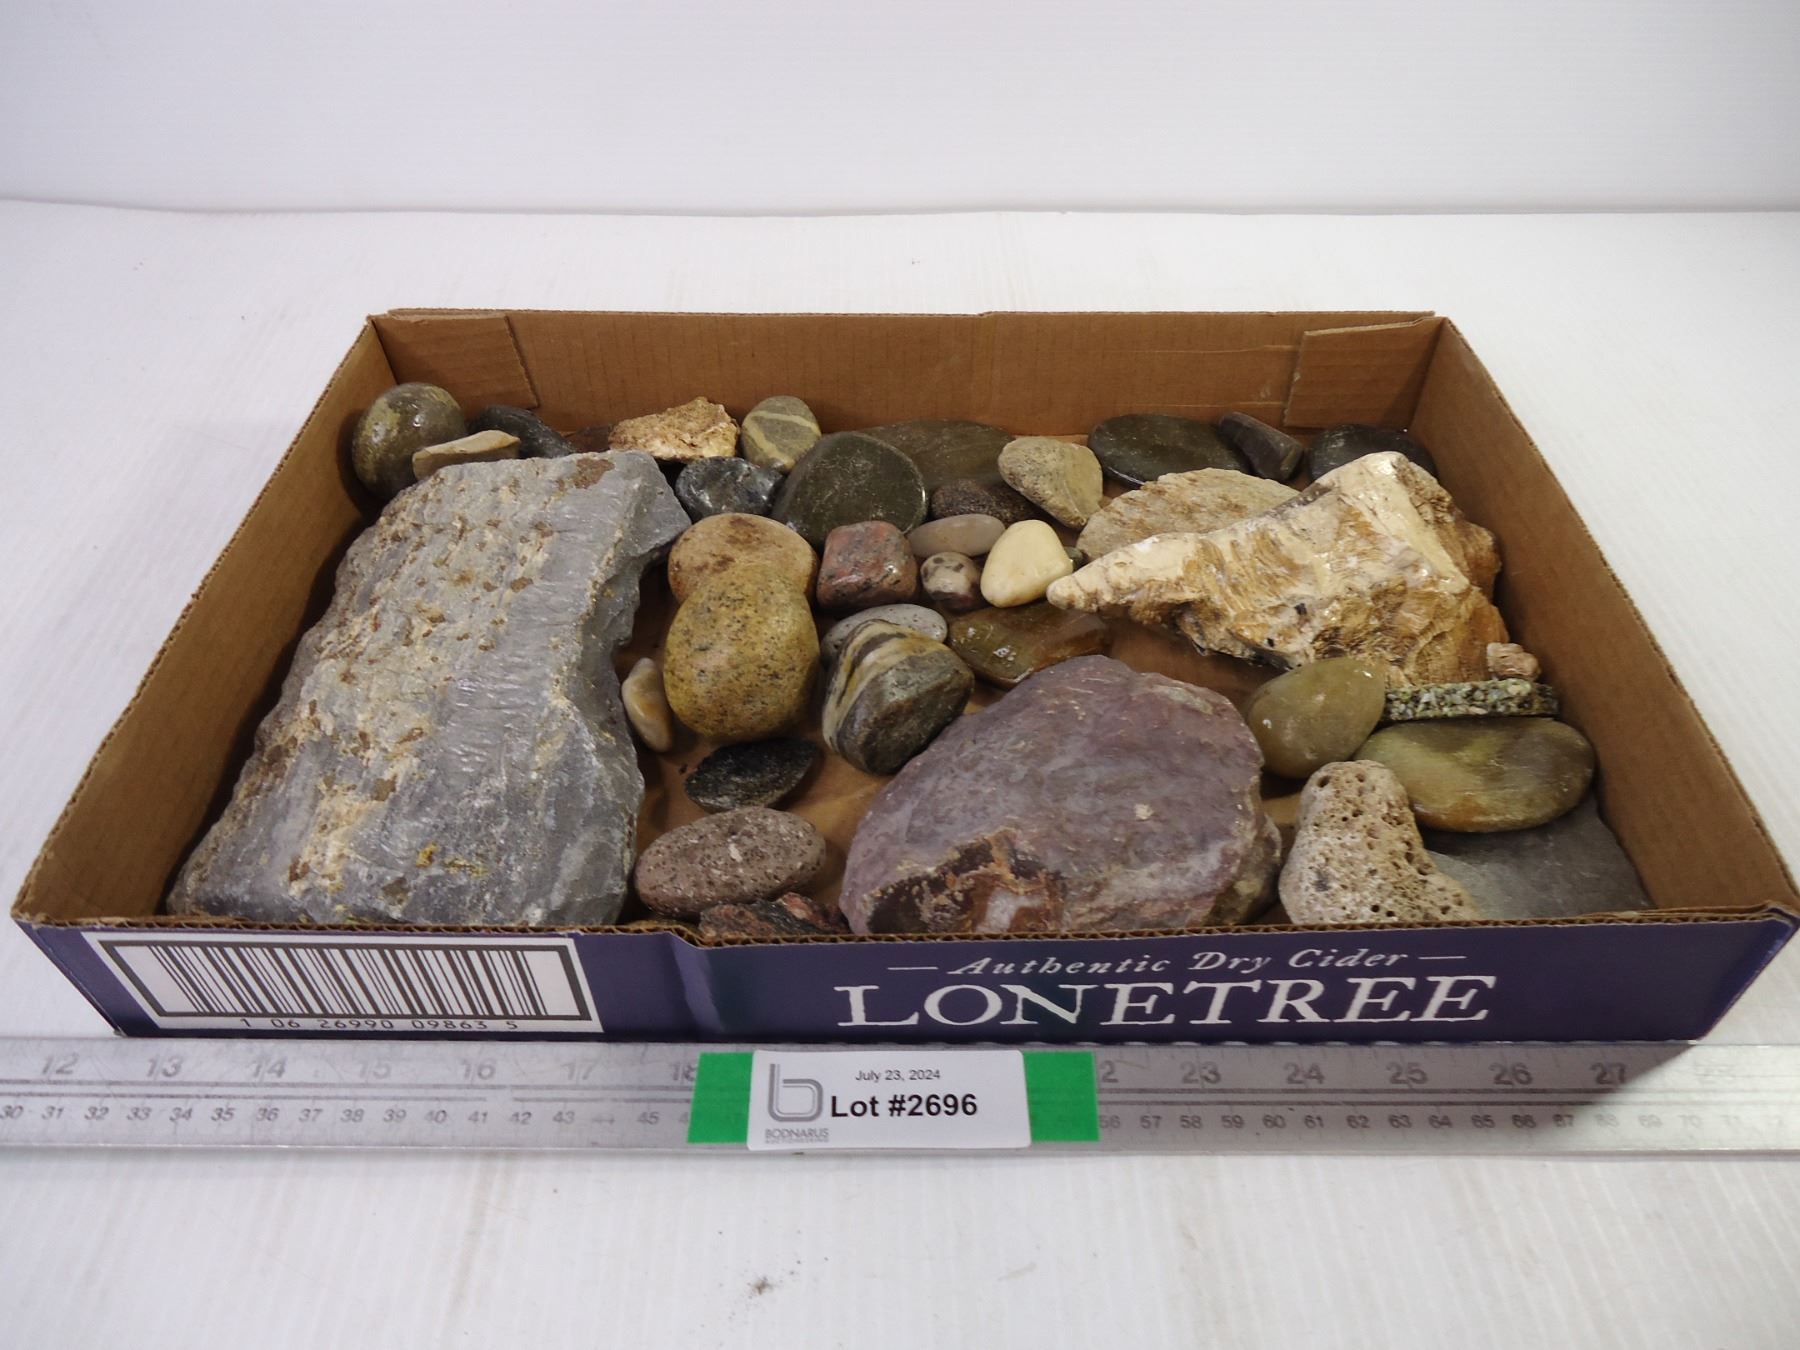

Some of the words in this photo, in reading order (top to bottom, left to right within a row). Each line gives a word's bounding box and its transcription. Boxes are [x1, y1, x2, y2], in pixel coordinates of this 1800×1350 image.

[947, 954, 1170, 975] Authentic
[1188, 951, 1272, 974] Dry
[1288, 948, 1408, 968] Cider
[833, 975, 1497, 1027] LONETREE
[240, 1018, 251, 1028] 1
[270, 1018, 301, 1029] 06
[319, 1019, 394, 1030] 26990
[411, 1020, 488, 1030] 09863
[509, 1021, 519, 1030] 5
[42, 1052, 78, 1075] 12
[147, 1054, 182, 1078] 13
[252, 1057, 287, 1078] 14
[358, 1059, 392, 1079] 15
[461, 1059, 496, 1080] 16
[562, 1061, 595, 1081] 17
[855, 1070, 880, 1083] July
[885, 1069, 905, 1082] 23,
[909, 1069, 941, 1080] 2024
[1100, 1060, 1119, 1083] 2
[1180, 1061, 1221, 1084] 23
[1283, 1062, 1325, 1085] 24
[1386, 1062, 1428, 1085] 25
[1489, 1062, 1533, 1085] 26
[1591, 1062, 1627, 1085] 27
[41, 1106, 64, 1120] 31
[84, 1106, 110, 1121] 32
[126, 1107, 152, 1121] 33
[169, 1107, 193, 1122] 34
[210, 1107, 236, 1122] 35
[256, 1107, 280, 1122] 36
[299, 1108, 323, 1122] 37
[340, 1109, 365, 1123] 38
[383, 1109, 407, 1123] 39
[424, 1109, 448, 1124] 40
[468, 1110, 488, 1124] 41
[509, 1111, 532, 1125] 42
[553, 1111, 575, 1125] 43
[637, 1111, 660, 1126] 45
[831, 1095, 880, 1118] Lot
[888, 1093, 978, 1117] #2696
[1140, 1115, 1162, 1129] 57
[1179, 1115, 1203, 1129] 58
[1221, 1115, 1245, 1129] 59
[1262, 1115, 1286, 1129] 60
[1304, 1115, 1324, 1129] 61
[1346, 1115, 1370, 1129] 62
[1388, 1115, 1412, 1129] 63
[1428, 1115, 1453, 1129] 64
[1471, 1115, 1495, 1129] 65
